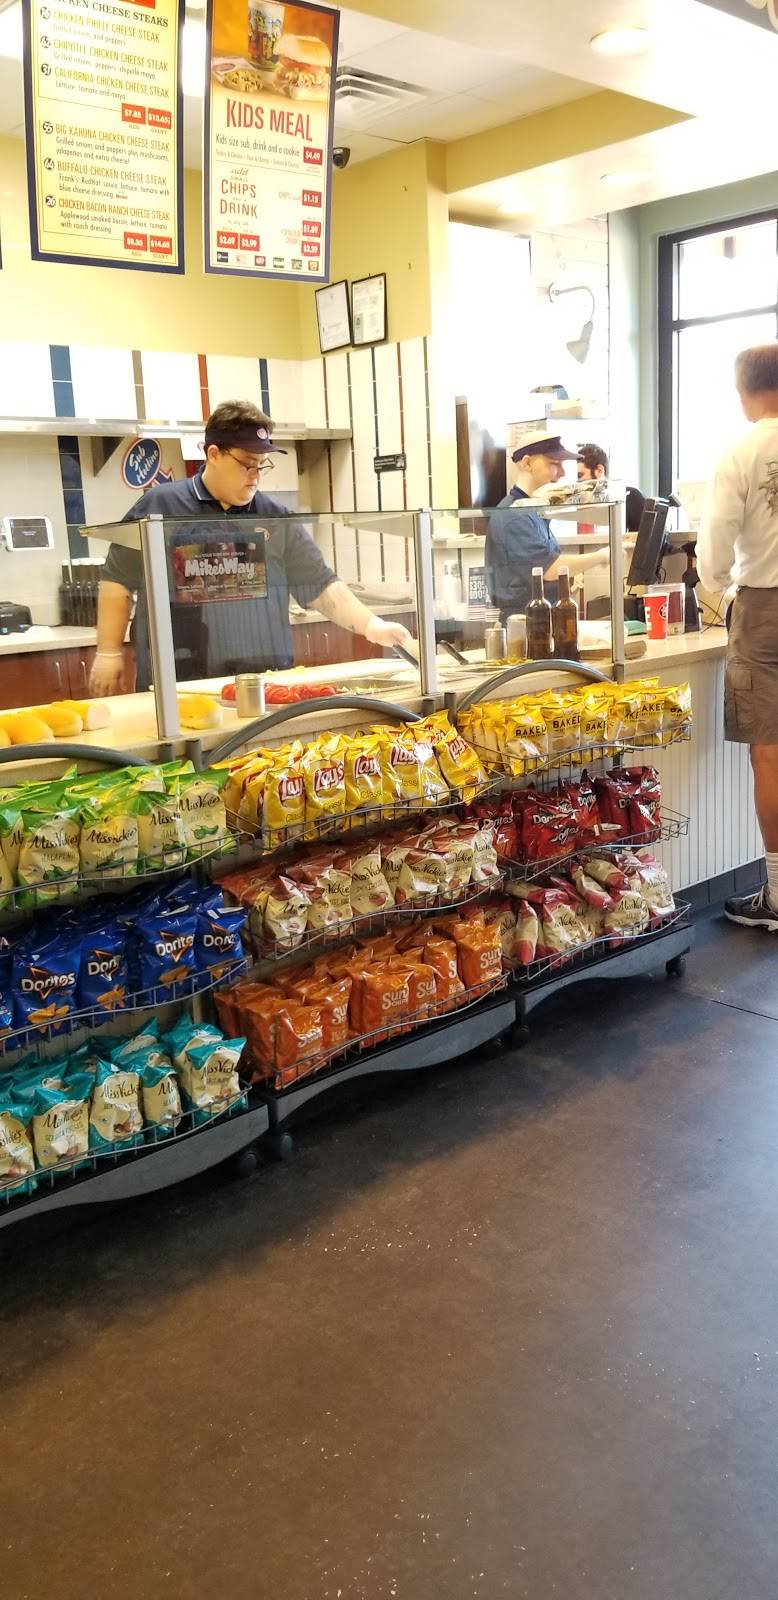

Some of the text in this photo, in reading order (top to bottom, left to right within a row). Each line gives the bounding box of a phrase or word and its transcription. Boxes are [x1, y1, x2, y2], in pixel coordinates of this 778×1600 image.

[92, 2, 130, 18] CHEESE
[132, 12, 168, 28] STEAKS
[111, 23, 137, 38] CHEESE
[138, 28, 160, 43] STEAK
[89, 46, 118, 62] CHICKEN
[120, 52, 145, 67] CHEESE
[146, 57, 168, 71] STEAK
[54, 66, 94, 83] CALIFORNIA
[96, 75, 123, 90] CHICKEN
[125, 81, 148, 95] CHEESE
[149, 86, 169, 99] STEAK
[226, 98, 313, 142] KIDS MEAL
[55, 123, 67, 135] BIG
[69, 126, 97, 139] KAHUNA
[98, 131, 125, 145] CHICKEN
[126, 136, 149, 149] CHEESE
[150, 140, 170, 152] STEAK
[55, 136, 74, 146] Grilled
[94, 143, 105, 151] and
[215, 133, 228, 145] Kids
[228, 137, 240, 147] size
[252, 139, 267, 152] drink
[267, 144, 279, 154] and
[283, 145, 300, 158] cookie
[83, 151, 94, 160] and
[305, 149, 321, 160] $4.49
[57, 161, 88, 175] BUFFALO
[89, 166, 119, 180] CHICKEN
[120, 171, 145, 183] CHEESE
[145, 174, 167, 186] STEAK
[72, 185, 91, 195] cheese
[91, 188, 114, 199] dressing
[159, 188, 170, 196] with
[221, 178, 256, 199] CHIPS
[58, 198, 86, 210] CHICKEN
[86, 201, 107, 213] BACON
[108, 204, 129, 216] RANCH
[129, 207, 151, 219] CHEESE
[151, 210, 169, 220] STEAK
[60, 210, 90, 221] Applewood
[91, 215, 112, 223] smoked
[220, 198, 258, 219] DRINK
[60, 220, 112, 234] with ranch dressing
[129, 445, 146, 472] Sub
[136, 450, 159, 484] Hotline
[21, 972, 76, 993] Doritos
